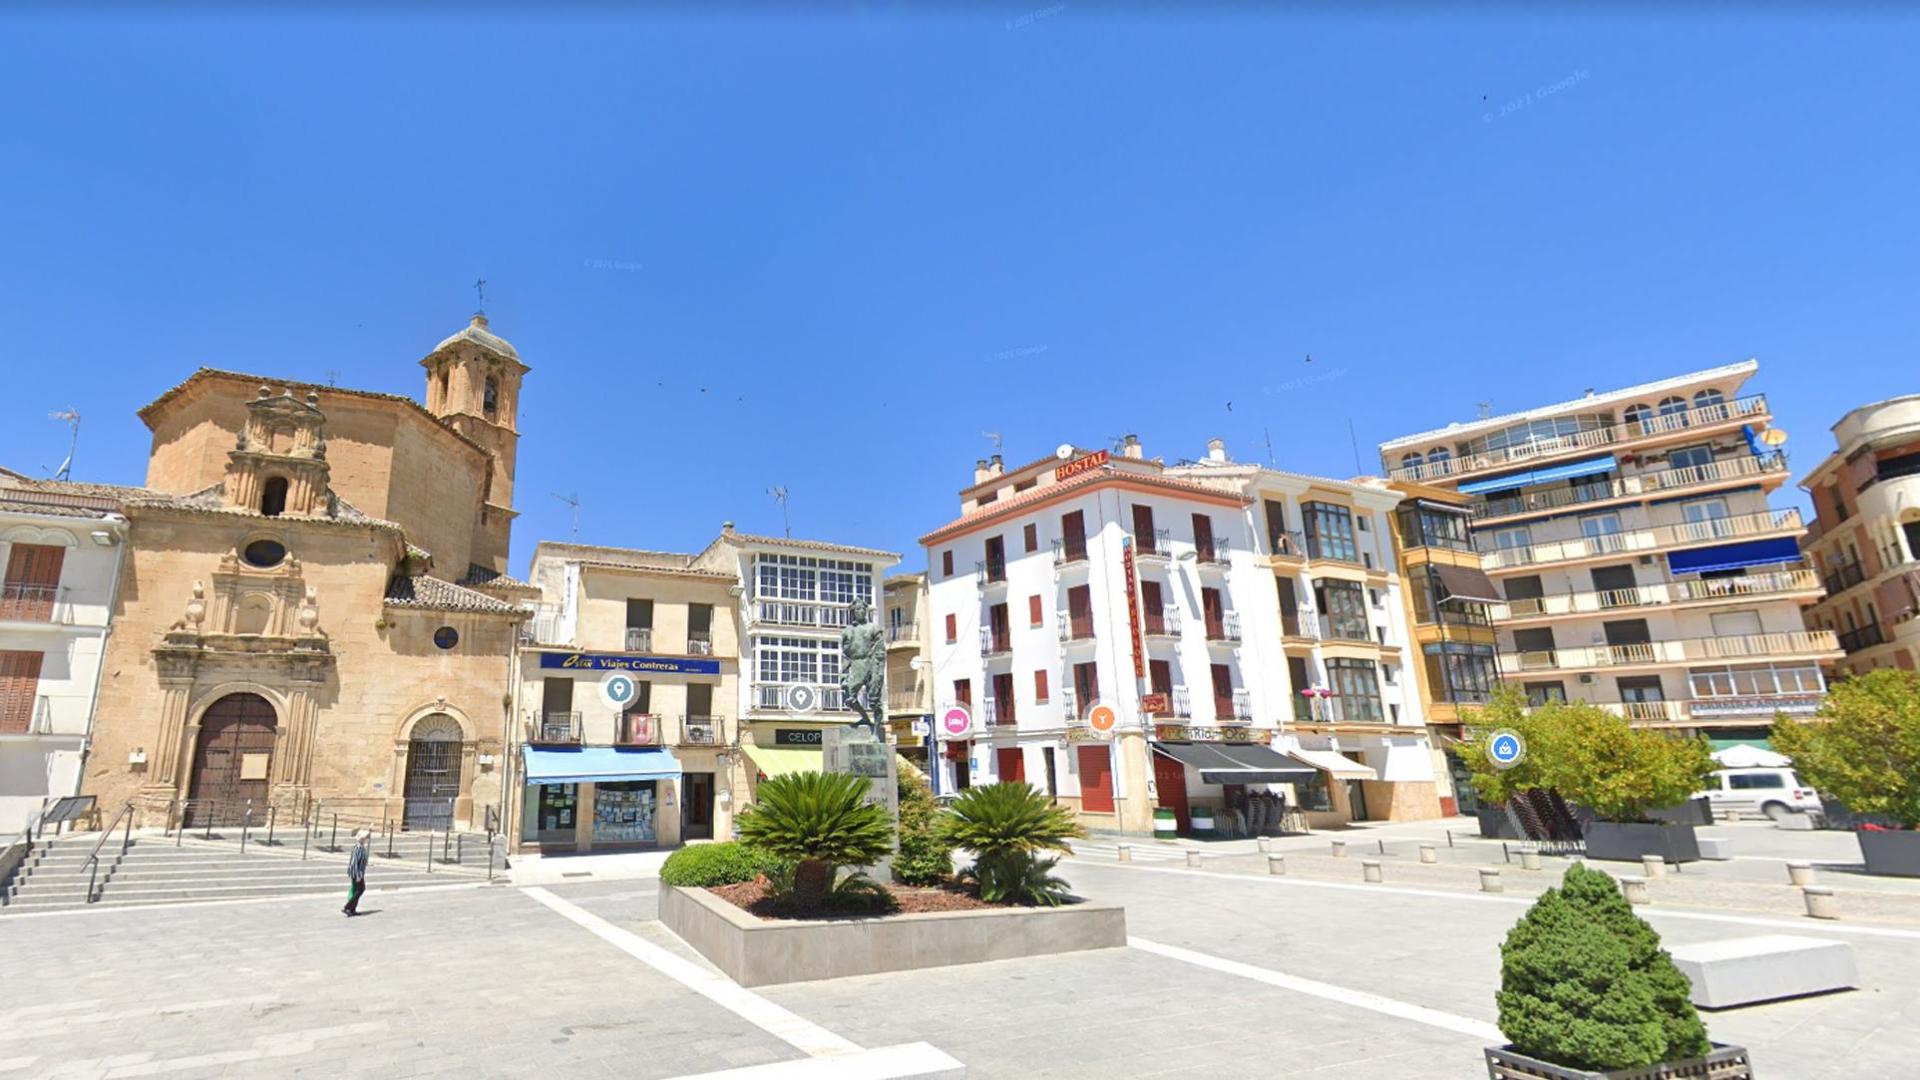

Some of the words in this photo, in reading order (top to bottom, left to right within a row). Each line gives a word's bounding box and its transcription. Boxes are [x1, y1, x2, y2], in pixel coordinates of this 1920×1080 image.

[1057, 452, 1106, 479] HOSTAL
[600, 659, 629, 670] Viajes
[632, 660, 679, 671] Contreras
[788, 732, 822, 742] CELOP
